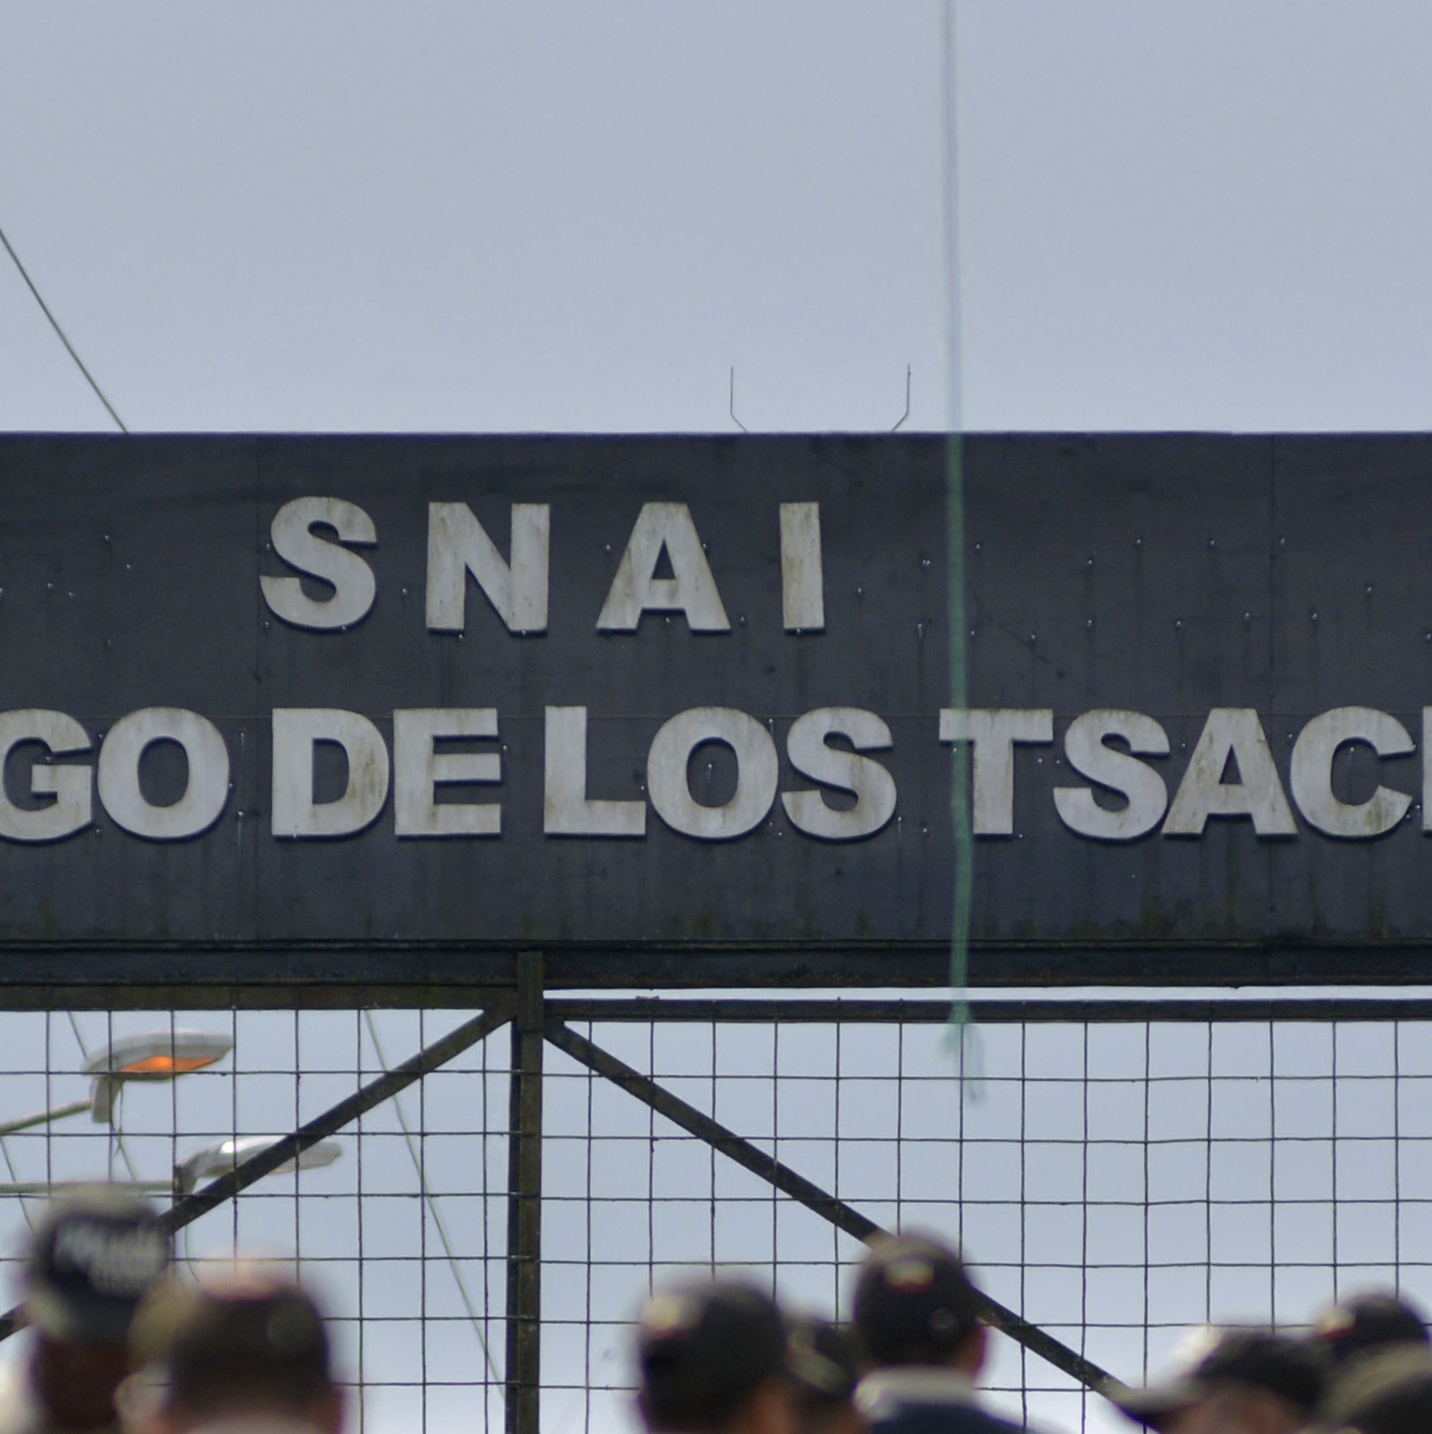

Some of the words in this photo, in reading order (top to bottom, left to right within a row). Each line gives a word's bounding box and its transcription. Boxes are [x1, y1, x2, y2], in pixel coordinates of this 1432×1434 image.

[260, 496, 826, 634] SNAI
[270, 707, 502, 838] DE
[543, 705, 898, 839] LOS
